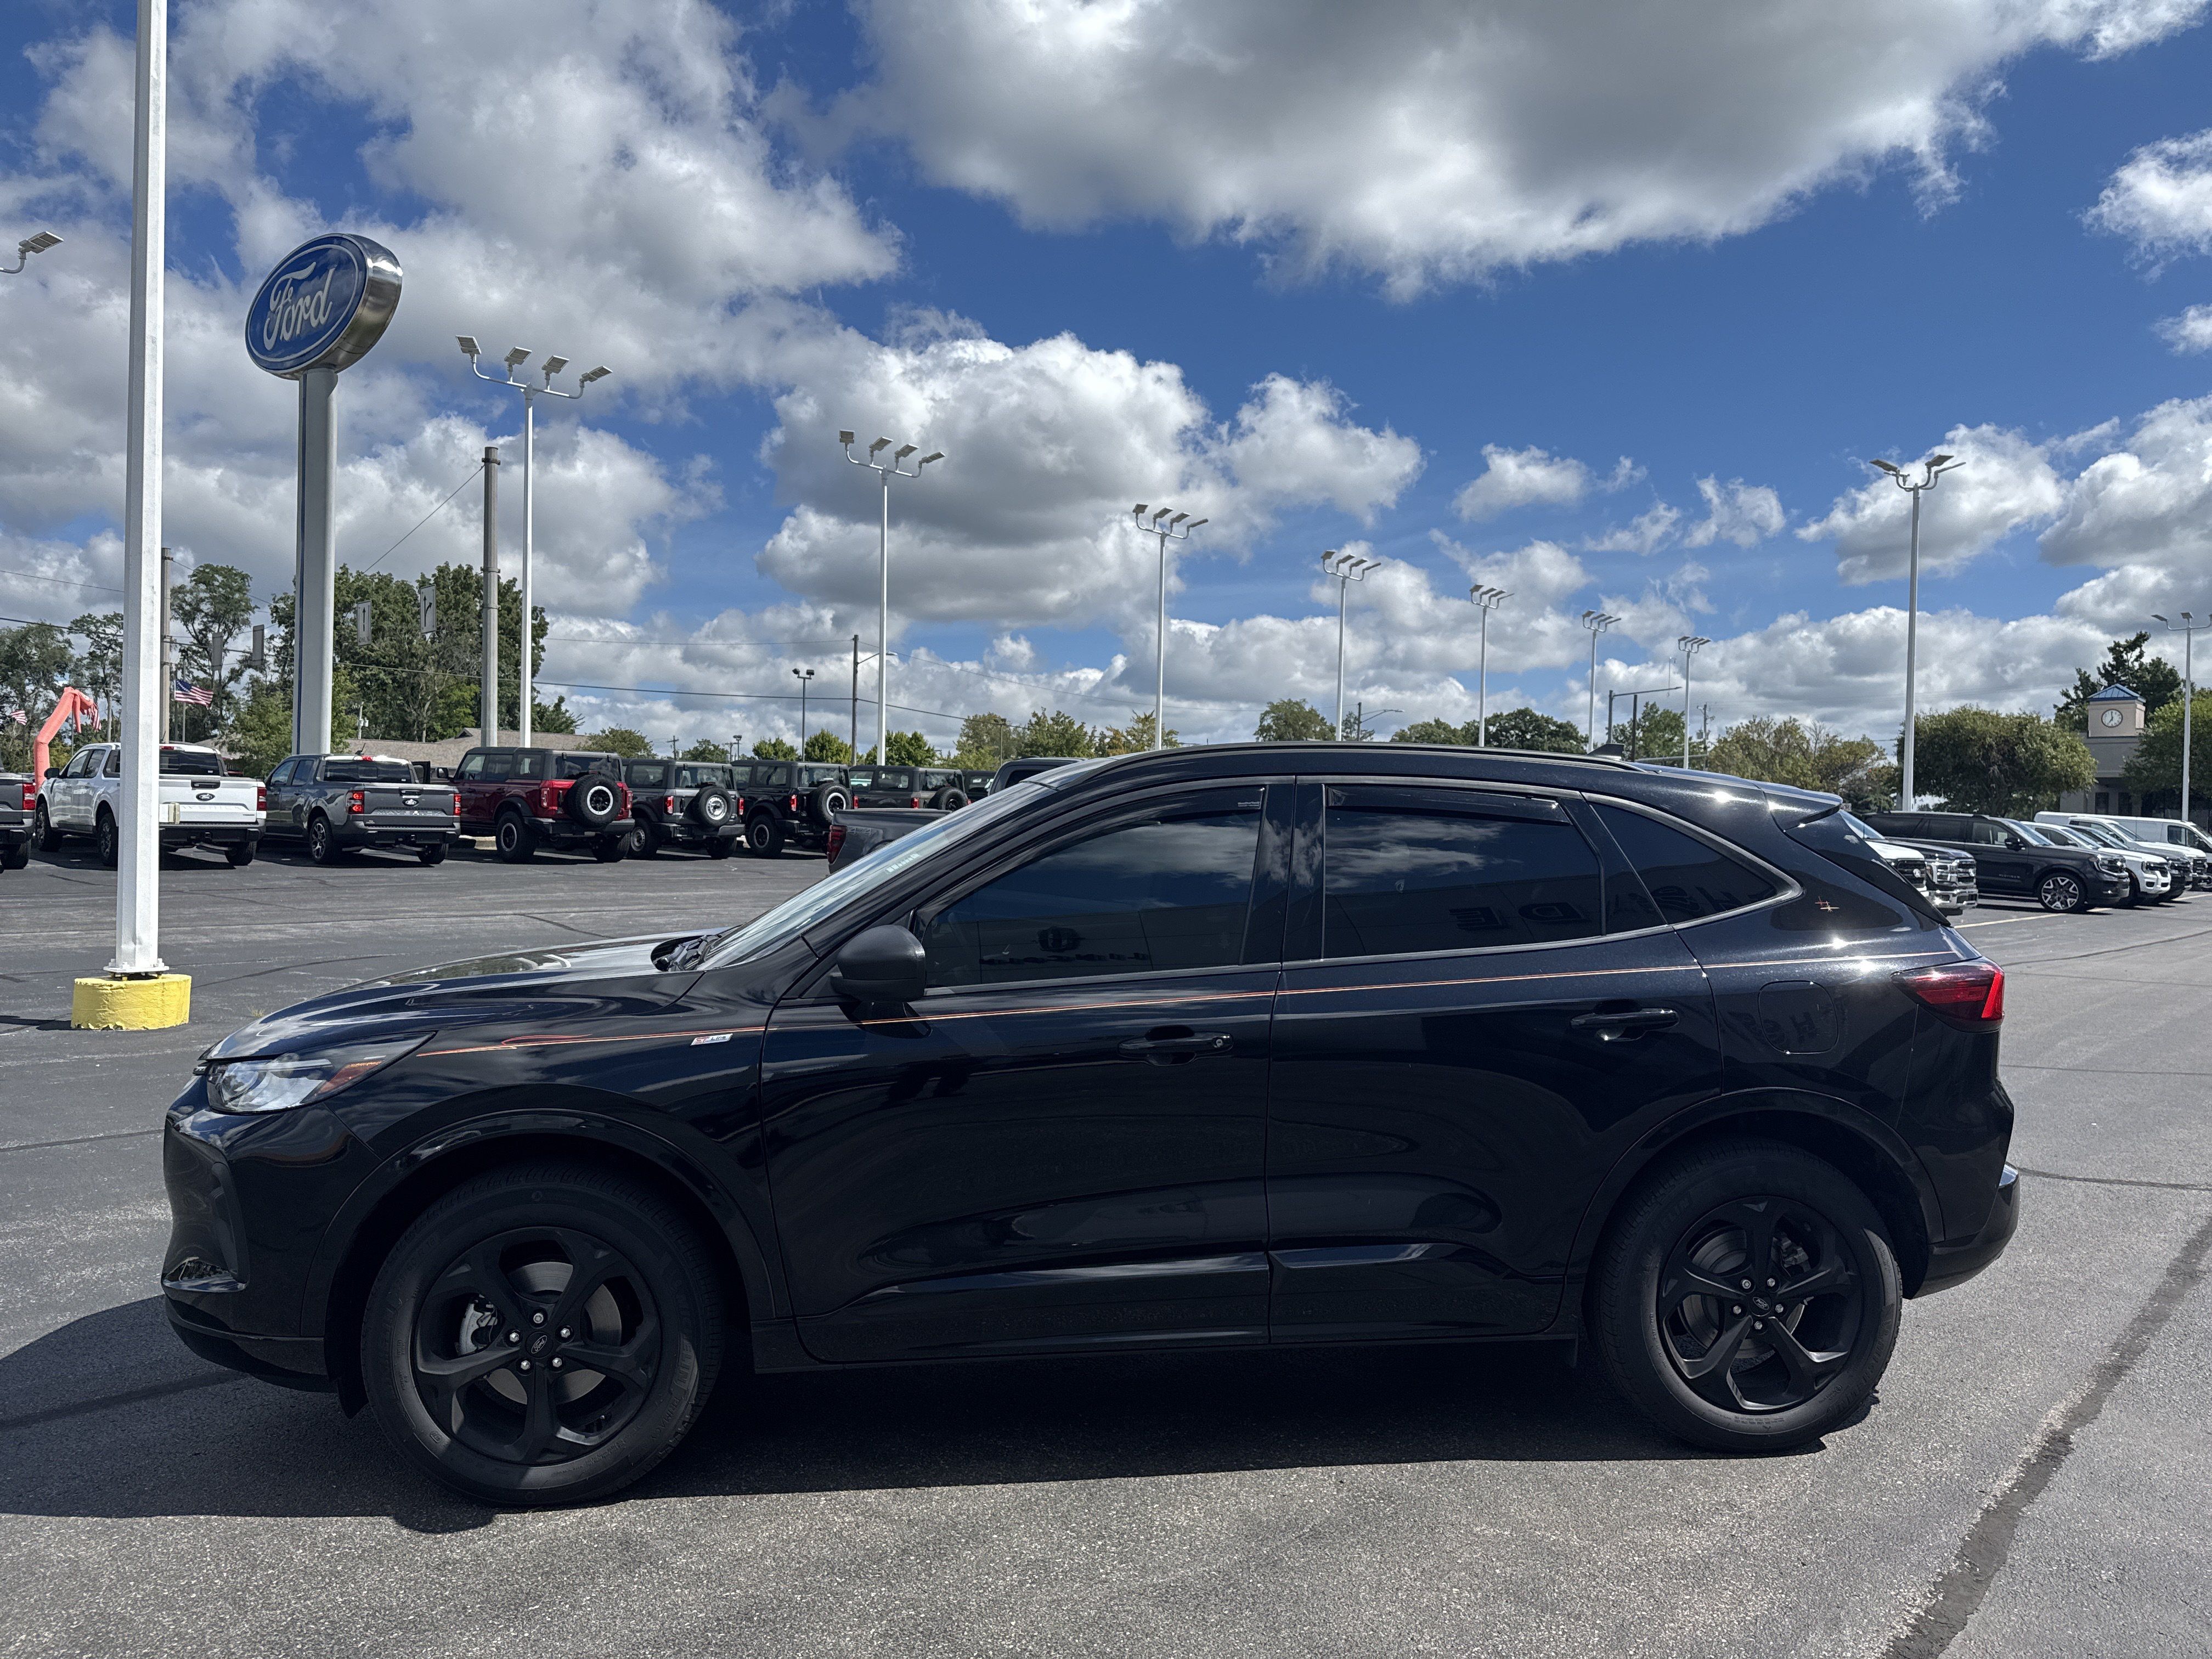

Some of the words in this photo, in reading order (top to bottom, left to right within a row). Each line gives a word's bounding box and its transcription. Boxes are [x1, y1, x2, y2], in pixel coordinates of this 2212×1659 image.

[263, 261, 338, 351] Ford
[1756, 1299, 1767, 1308] Ford
[534, 1338, 545, 1352] Ford
